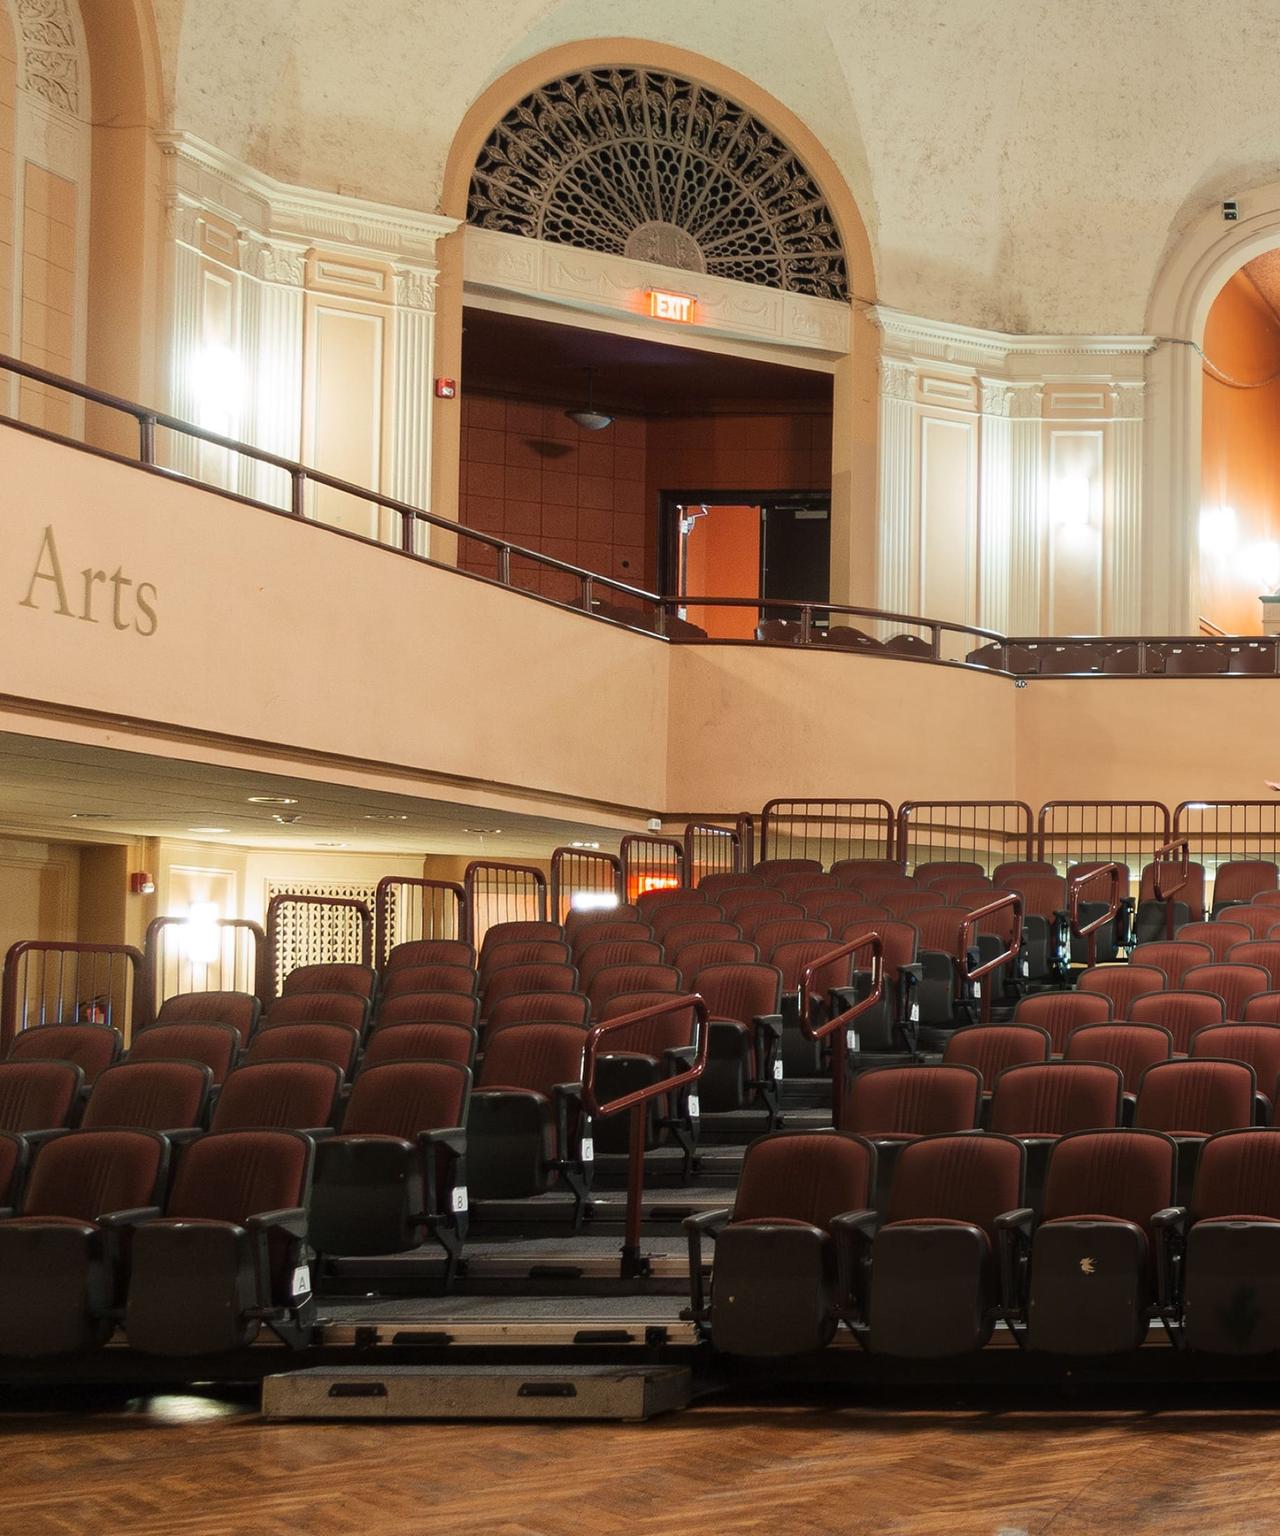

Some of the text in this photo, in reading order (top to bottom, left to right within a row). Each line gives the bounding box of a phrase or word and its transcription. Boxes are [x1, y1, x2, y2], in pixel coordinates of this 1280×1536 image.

[656, 292, 690, 321] EXIT
[18, 524, 157, 637] Arts
[298, 1276, 306, 1291] A
